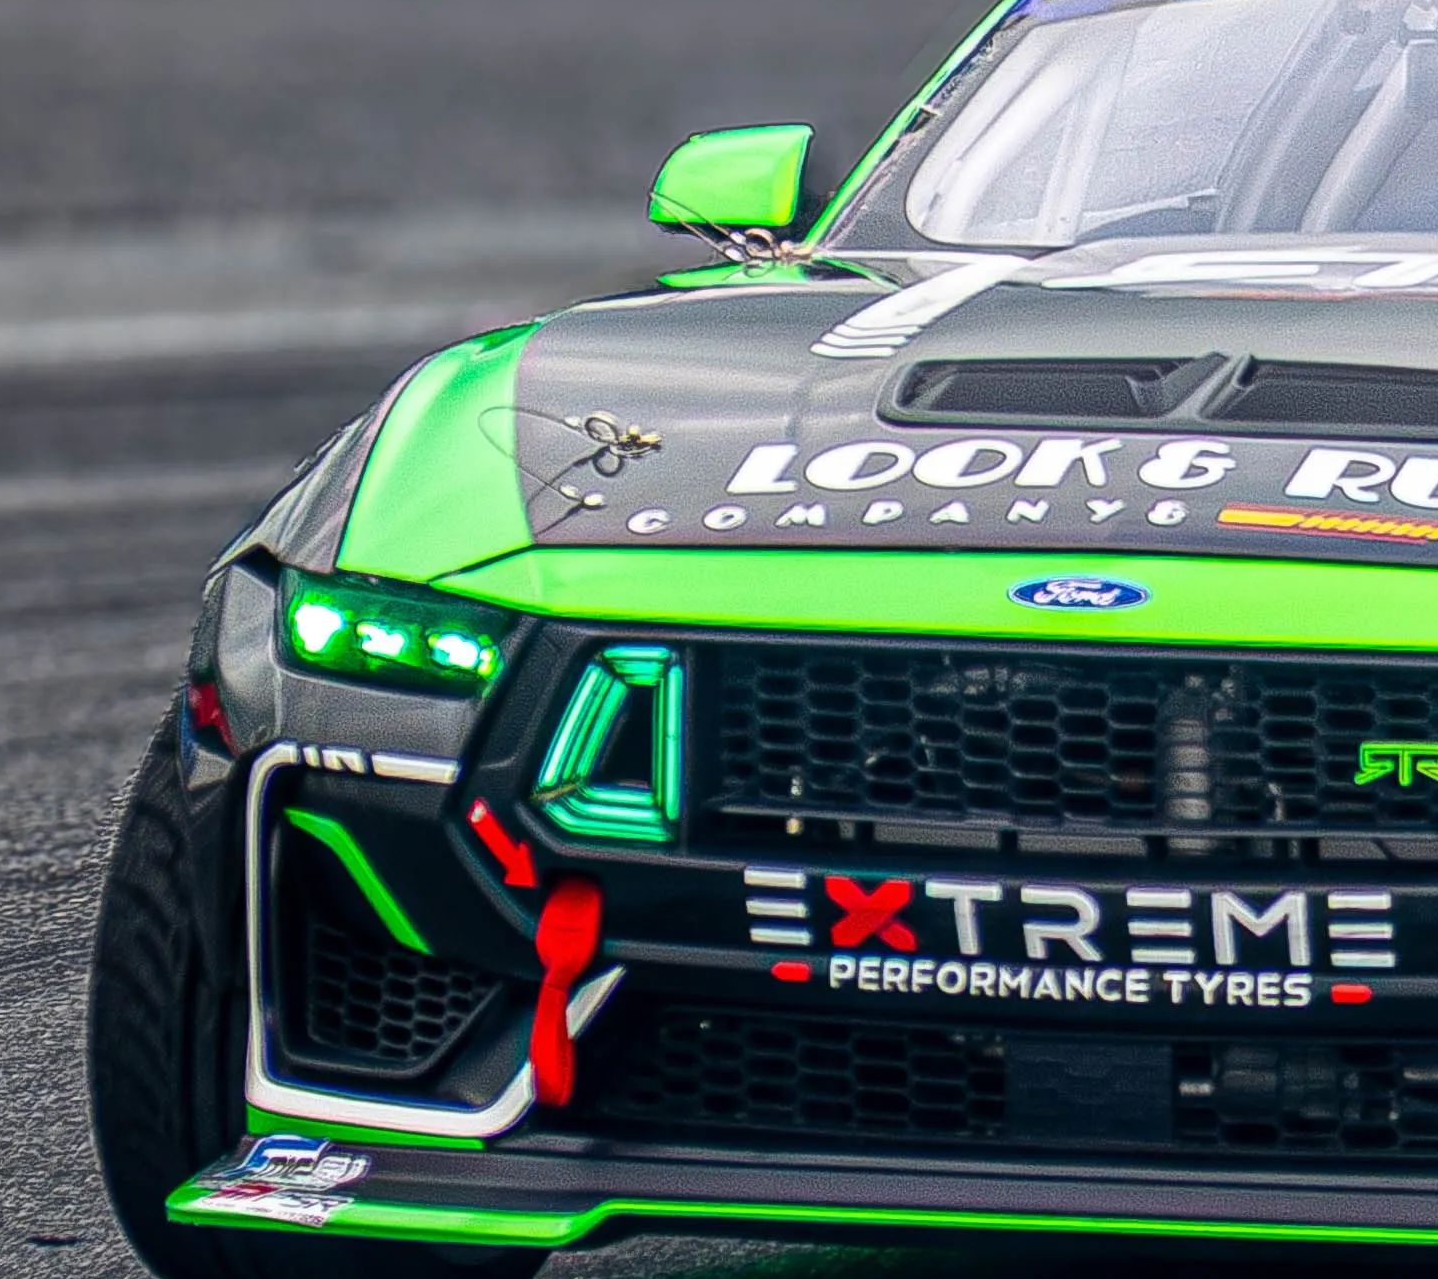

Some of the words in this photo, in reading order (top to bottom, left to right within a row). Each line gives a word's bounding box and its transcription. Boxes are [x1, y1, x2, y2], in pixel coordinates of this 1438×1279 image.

[726, 438, 1123, 494] LOOK
[627, 499, 1125, 534] COMPANY
[742, 864, 1397, 969] EXTREME
[828, 954, 1151, 1004] PERFORMANCE
[1162, 970, 1314, 1008] TYRES
